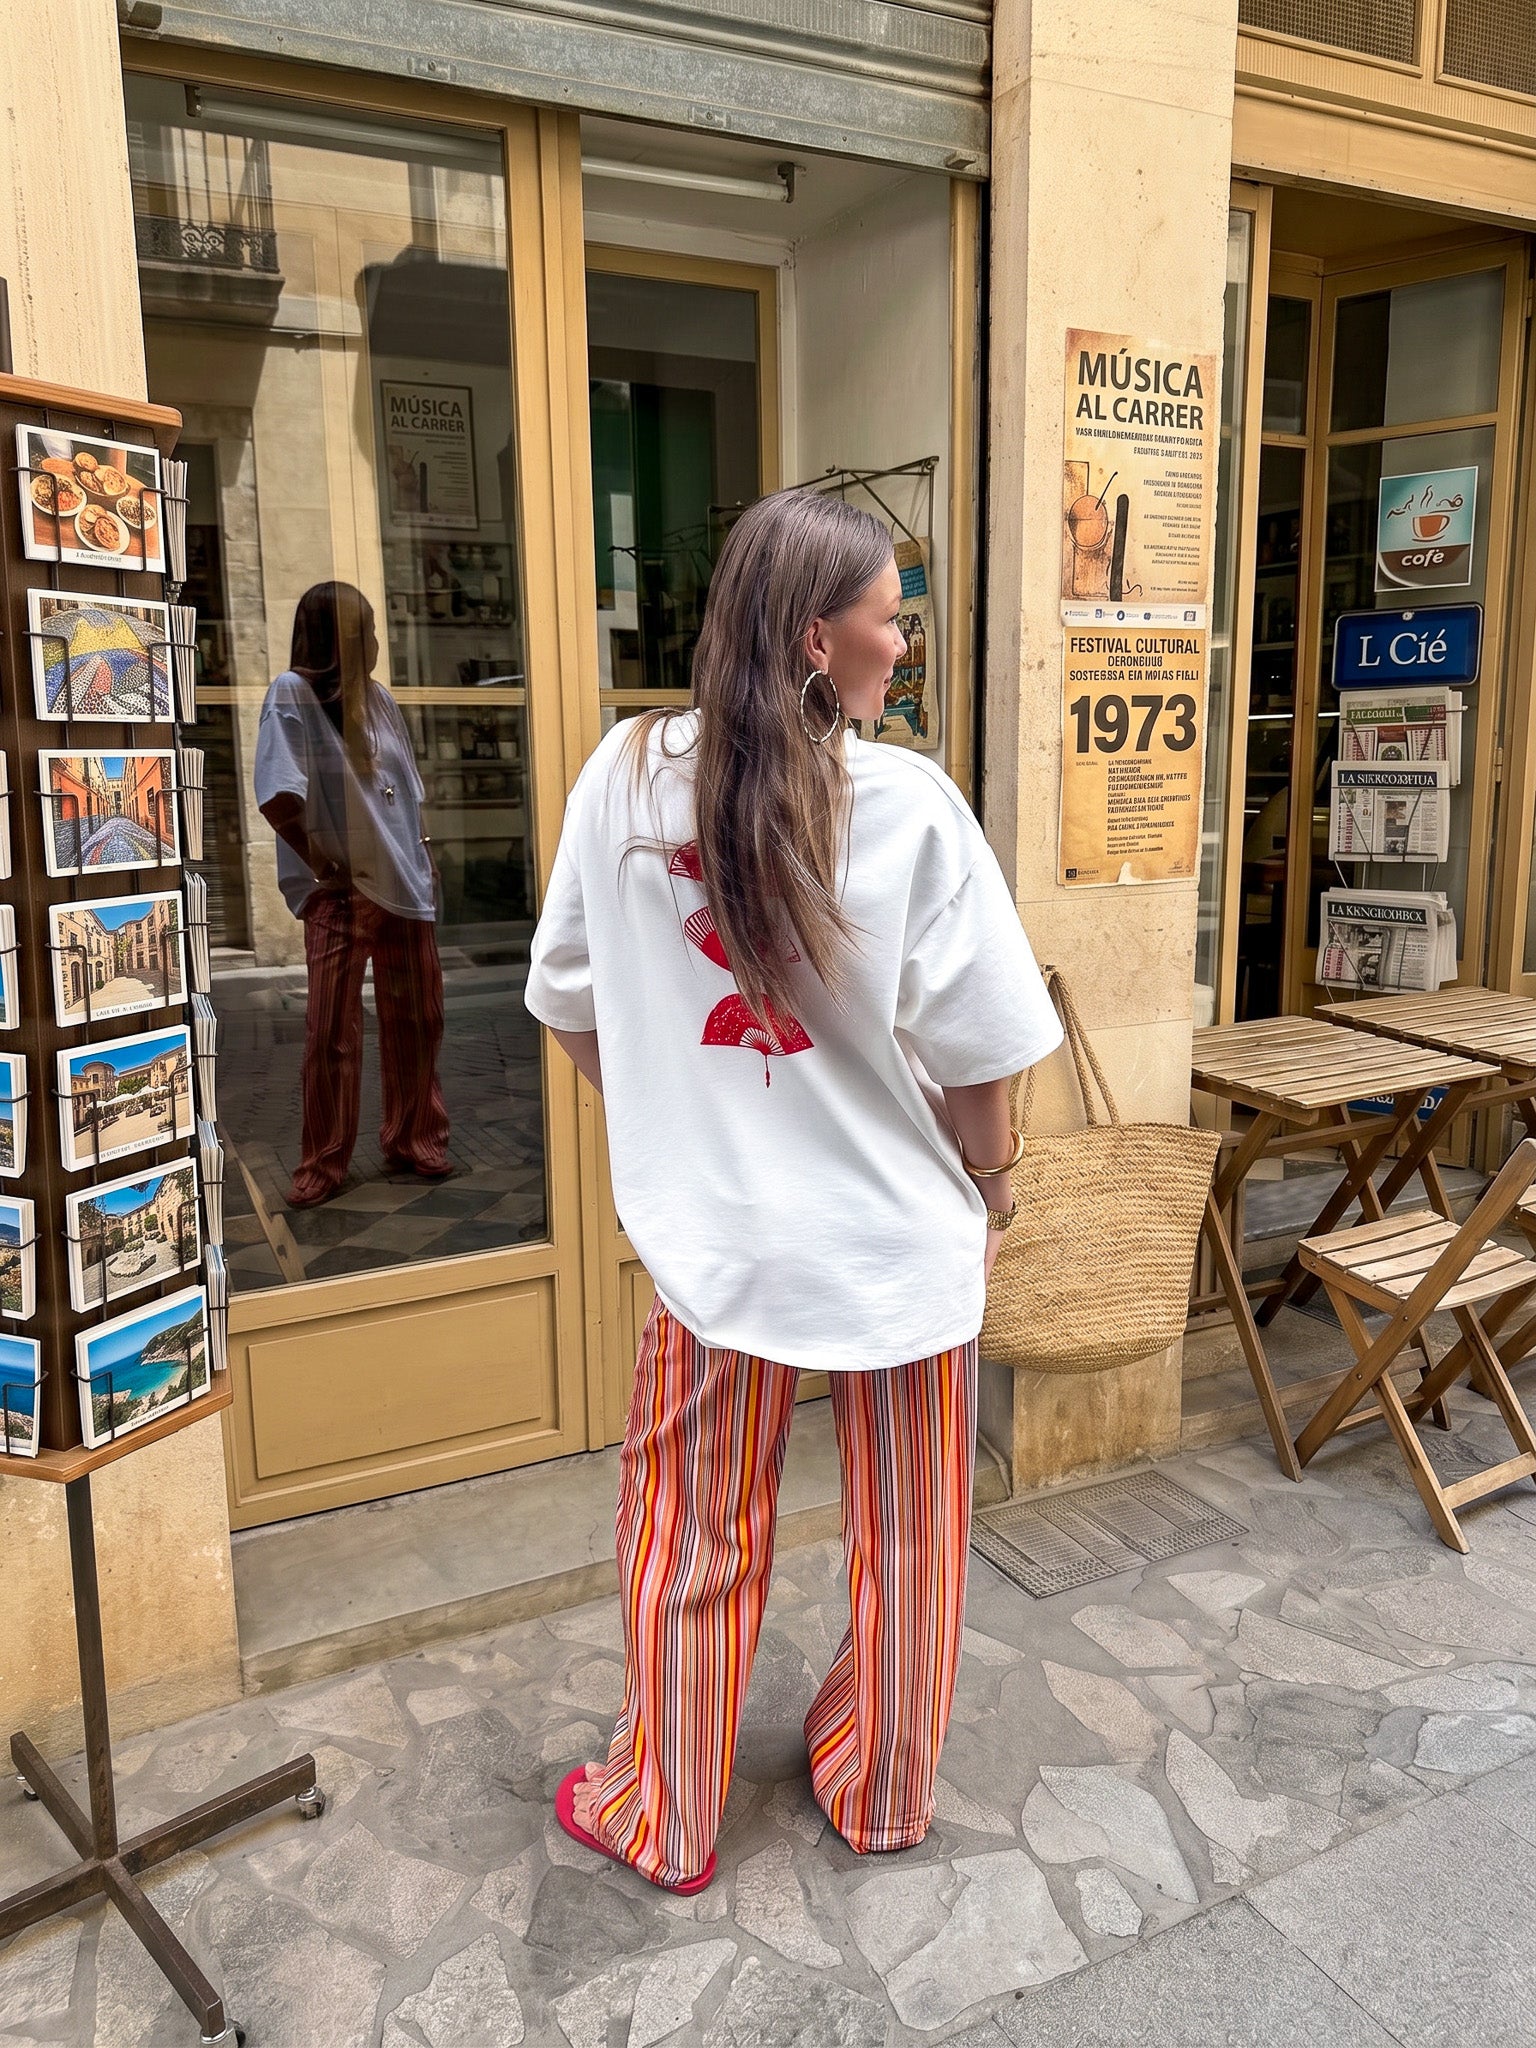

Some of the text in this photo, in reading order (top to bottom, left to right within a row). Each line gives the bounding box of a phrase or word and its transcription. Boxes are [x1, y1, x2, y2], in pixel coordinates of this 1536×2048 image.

[1078, 348, 1204, 399] MÚSICA
[390, 394, 463, 418] MÚSICA
[1076, 393, 1204, 430] AL CARRER
[391, 415, 465, 433] AL CARRER
[1070, 637, 1200, 654] FESTIVAL CULTURAL
[1358, 635, 1381, 667] L
[1070, 693, 1197, 754] 1973
[1340, 773, 1355, 784] LA
